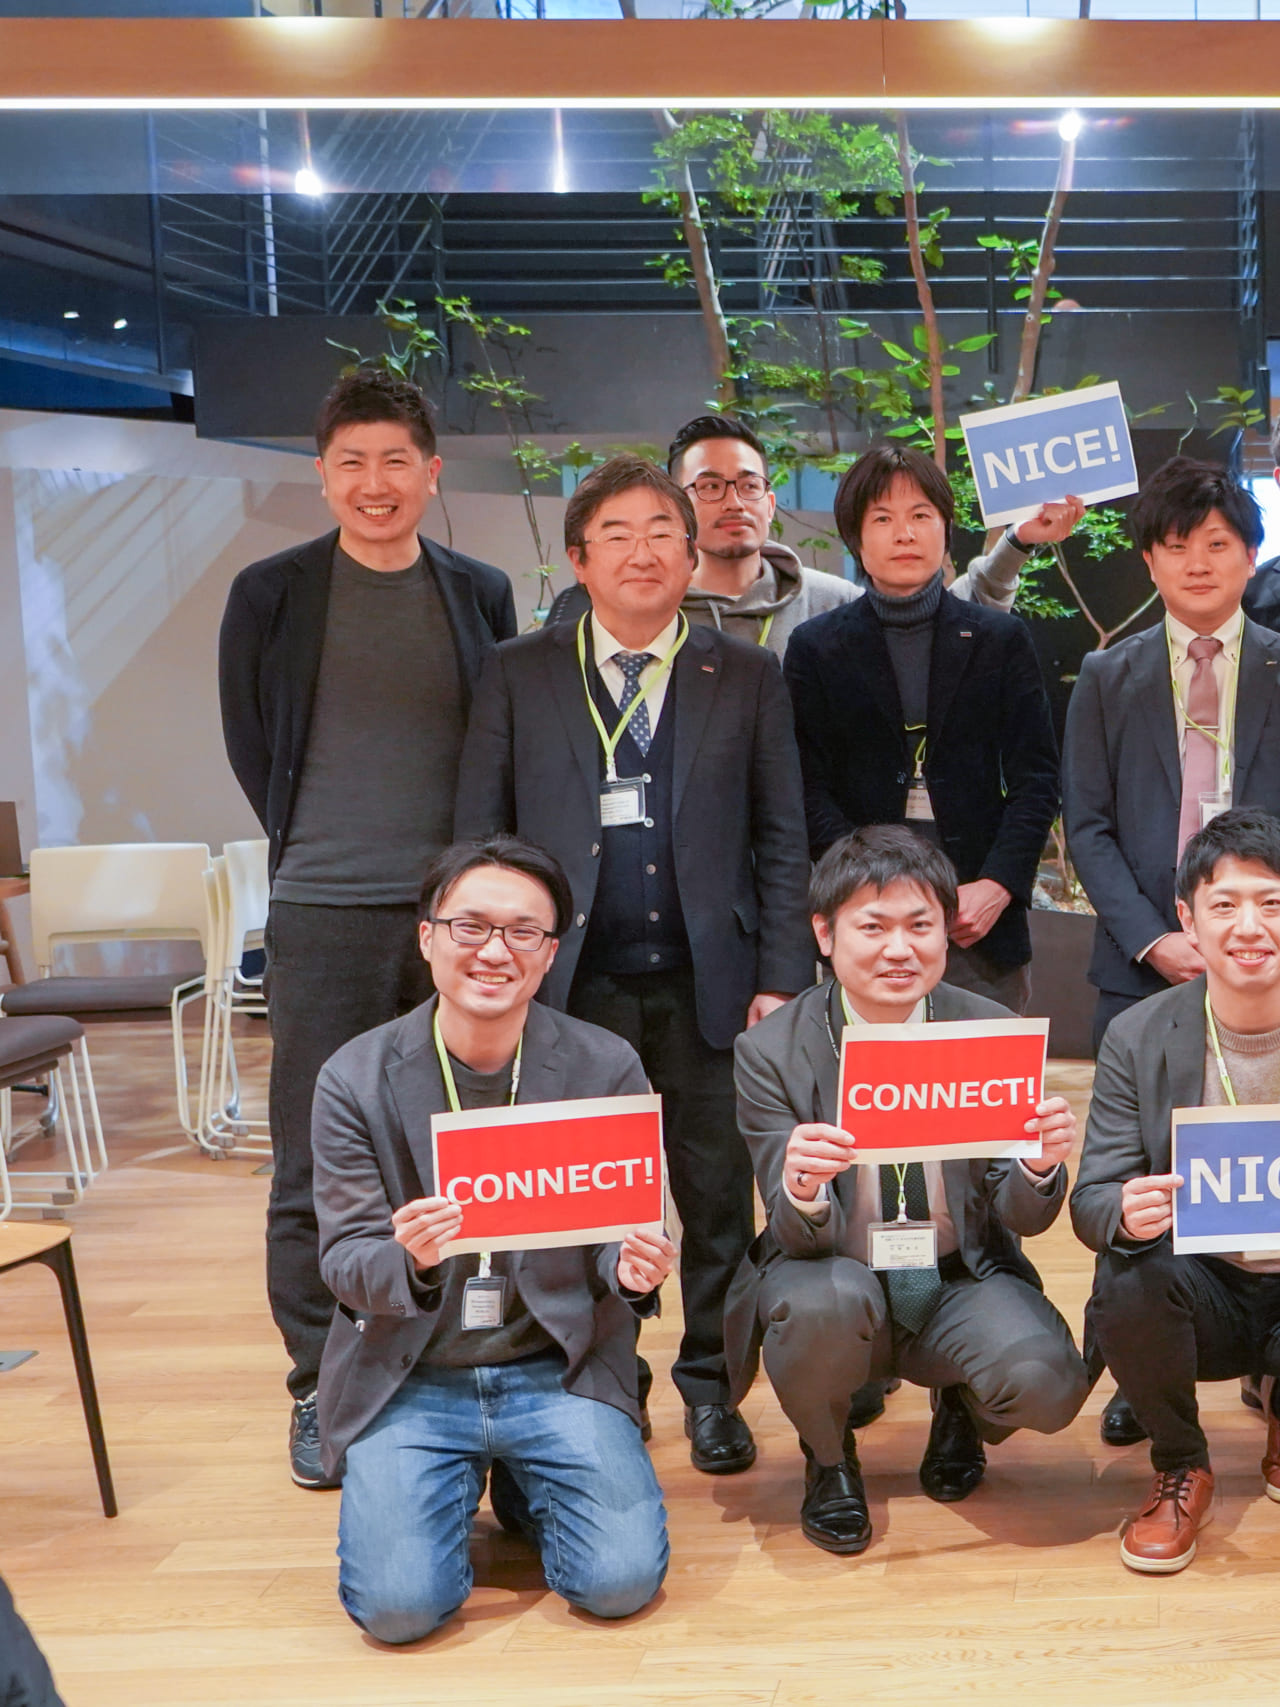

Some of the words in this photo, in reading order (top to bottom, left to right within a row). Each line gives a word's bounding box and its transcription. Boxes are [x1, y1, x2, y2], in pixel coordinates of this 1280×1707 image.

[982, 424, 1122, 489] NICE!
[847, 1076, 1035, 1111] CONNECT!
[446, 1156, 654, 1206] CONNECT!
